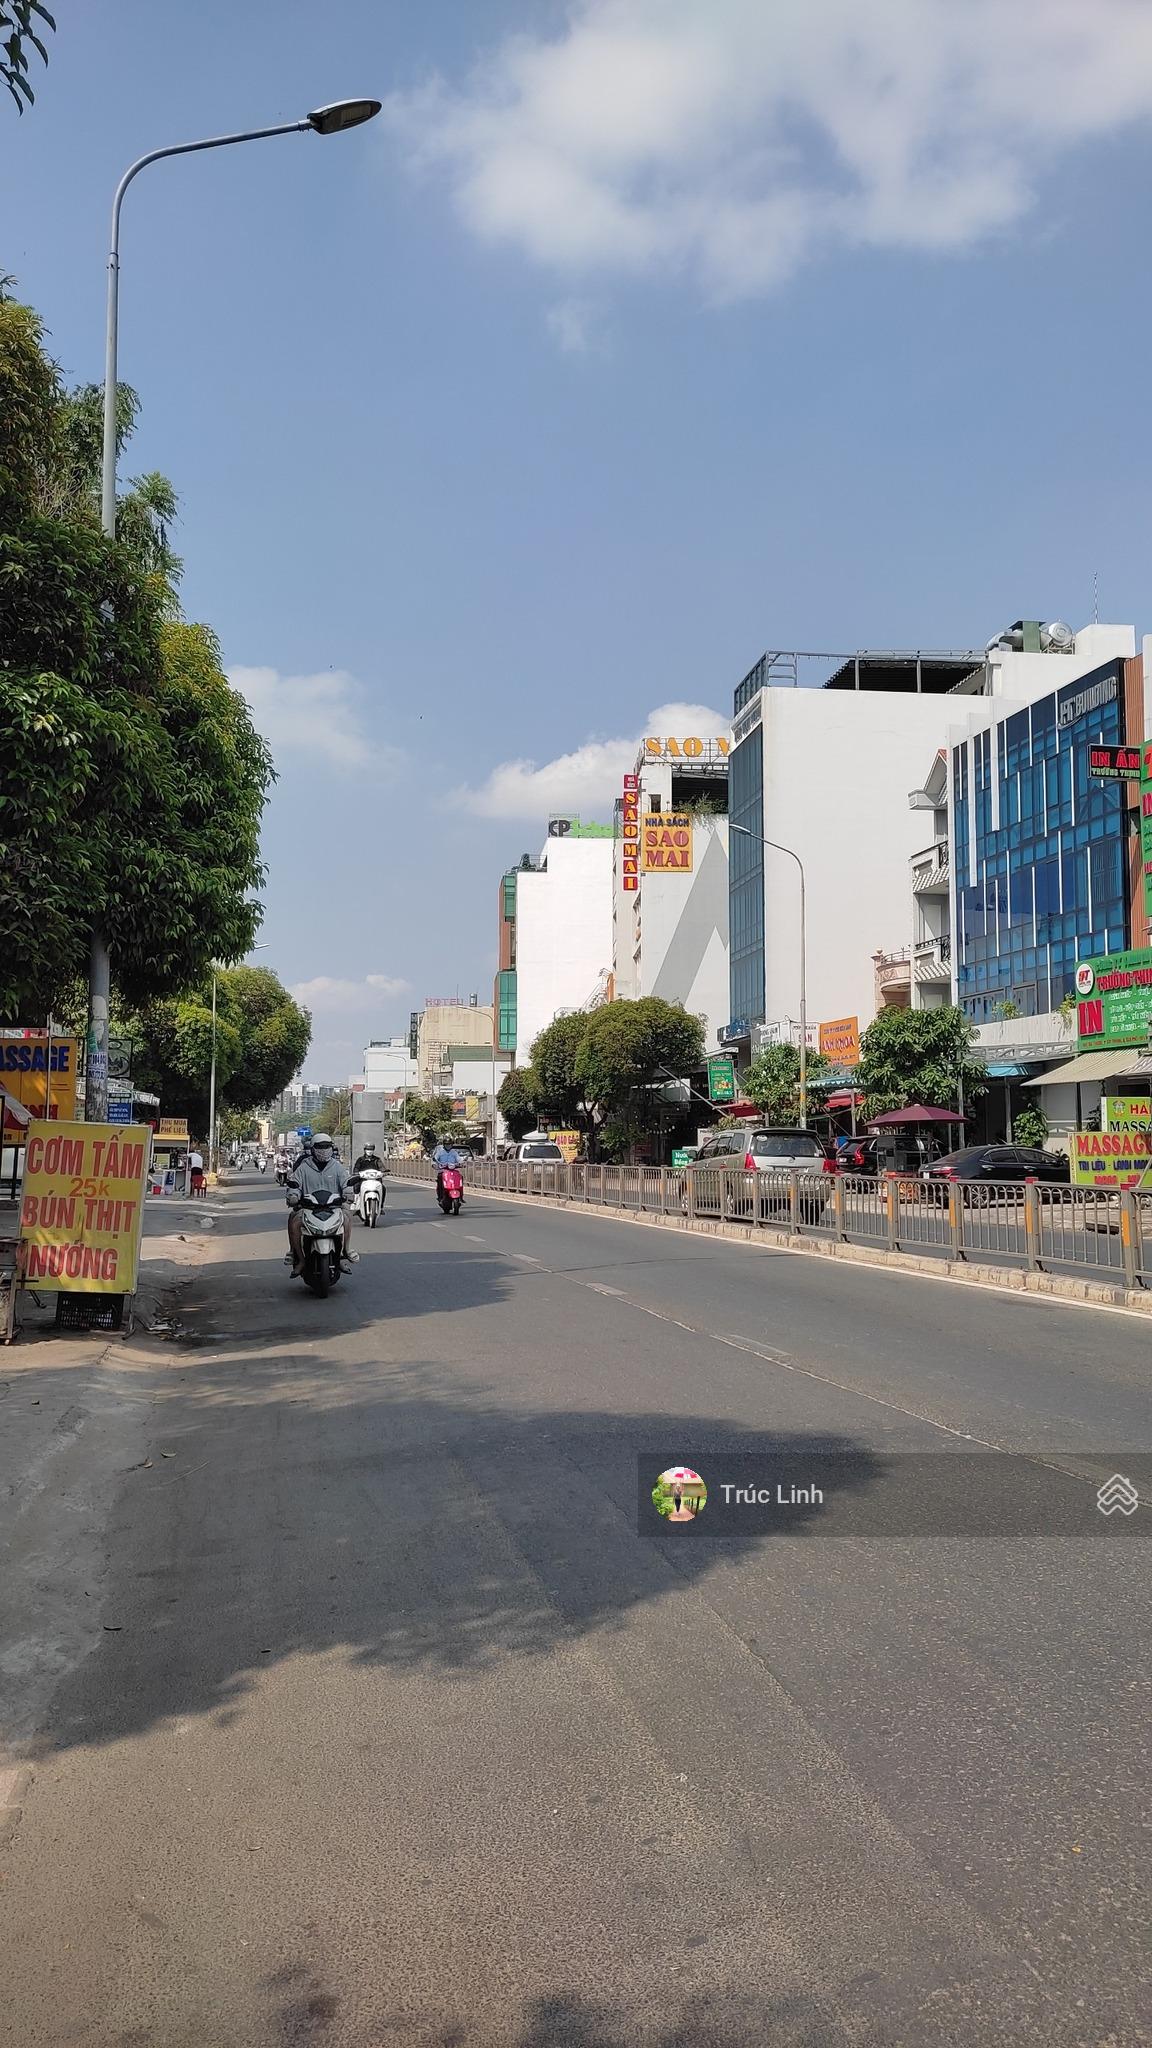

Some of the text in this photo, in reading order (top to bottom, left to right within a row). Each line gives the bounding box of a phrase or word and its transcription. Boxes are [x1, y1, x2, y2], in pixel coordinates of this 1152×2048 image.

[646, 737, 704, 757] SAO
[1091, 751, 1110, 767] IN
[645, 815, 689, 827] NHÀ SÁCH
[646, 831, 689, 847] SAO
[646, 851, 689, 867] MAI
[1078, 999, 1103, 1035] IN
[28, 1130, 144, 1179] CƠM TẤM
[69, 1177, 111, 1198] 25k
[22, 1190, 137, 1240] BÚN THỊT
[28, 1240, 118, 1281] NƯỚNG
